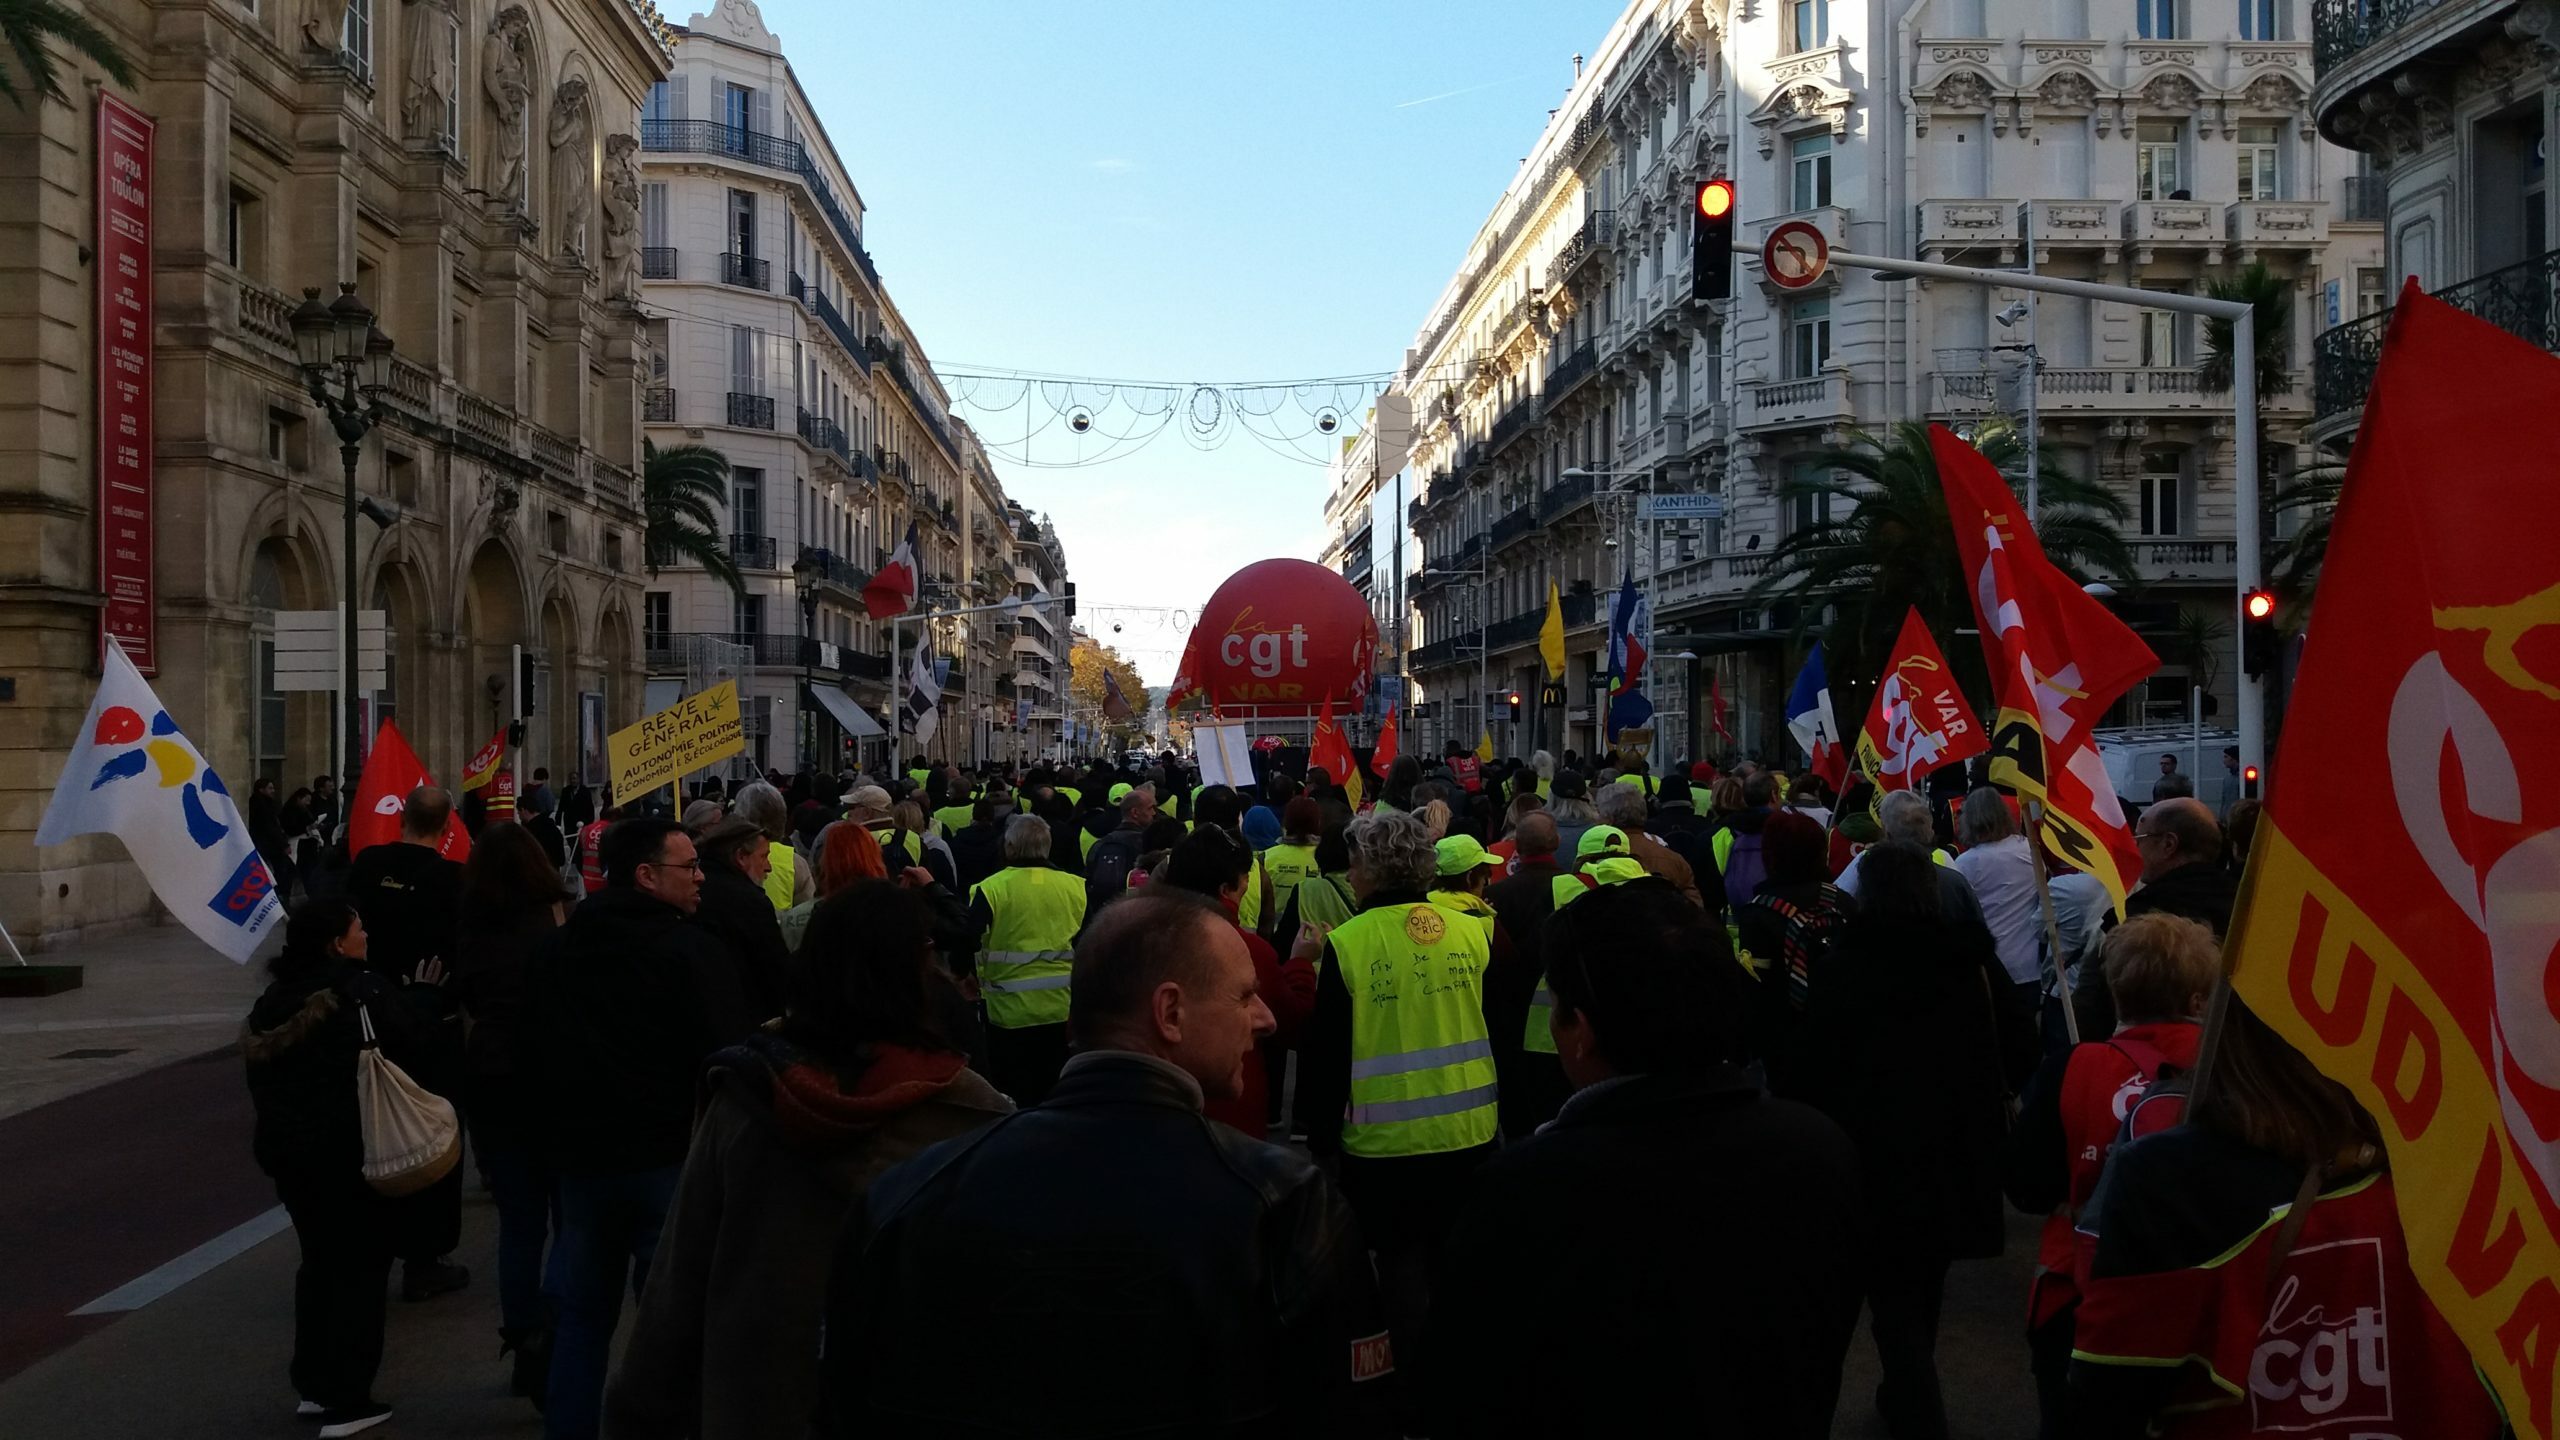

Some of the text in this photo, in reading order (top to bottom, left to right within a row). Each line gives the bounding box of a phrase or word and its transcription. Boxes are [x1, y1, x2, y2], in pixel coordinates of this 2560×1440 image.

[113, 151, 142, 181] OPÉRA
[111, 176, 144, 208] TOULON
[1221, 624, 1308, 678] cgt
[1229, 683, 1304, 700] VAR
[642, 699, 698, 736] RÊVE
[1933, 689, 1968, 738] VAR
[684, 753, 693, 765] &
[1422, 924, 1441, 934] RIC
[2248, 1305, 2387, 1415] cgt
